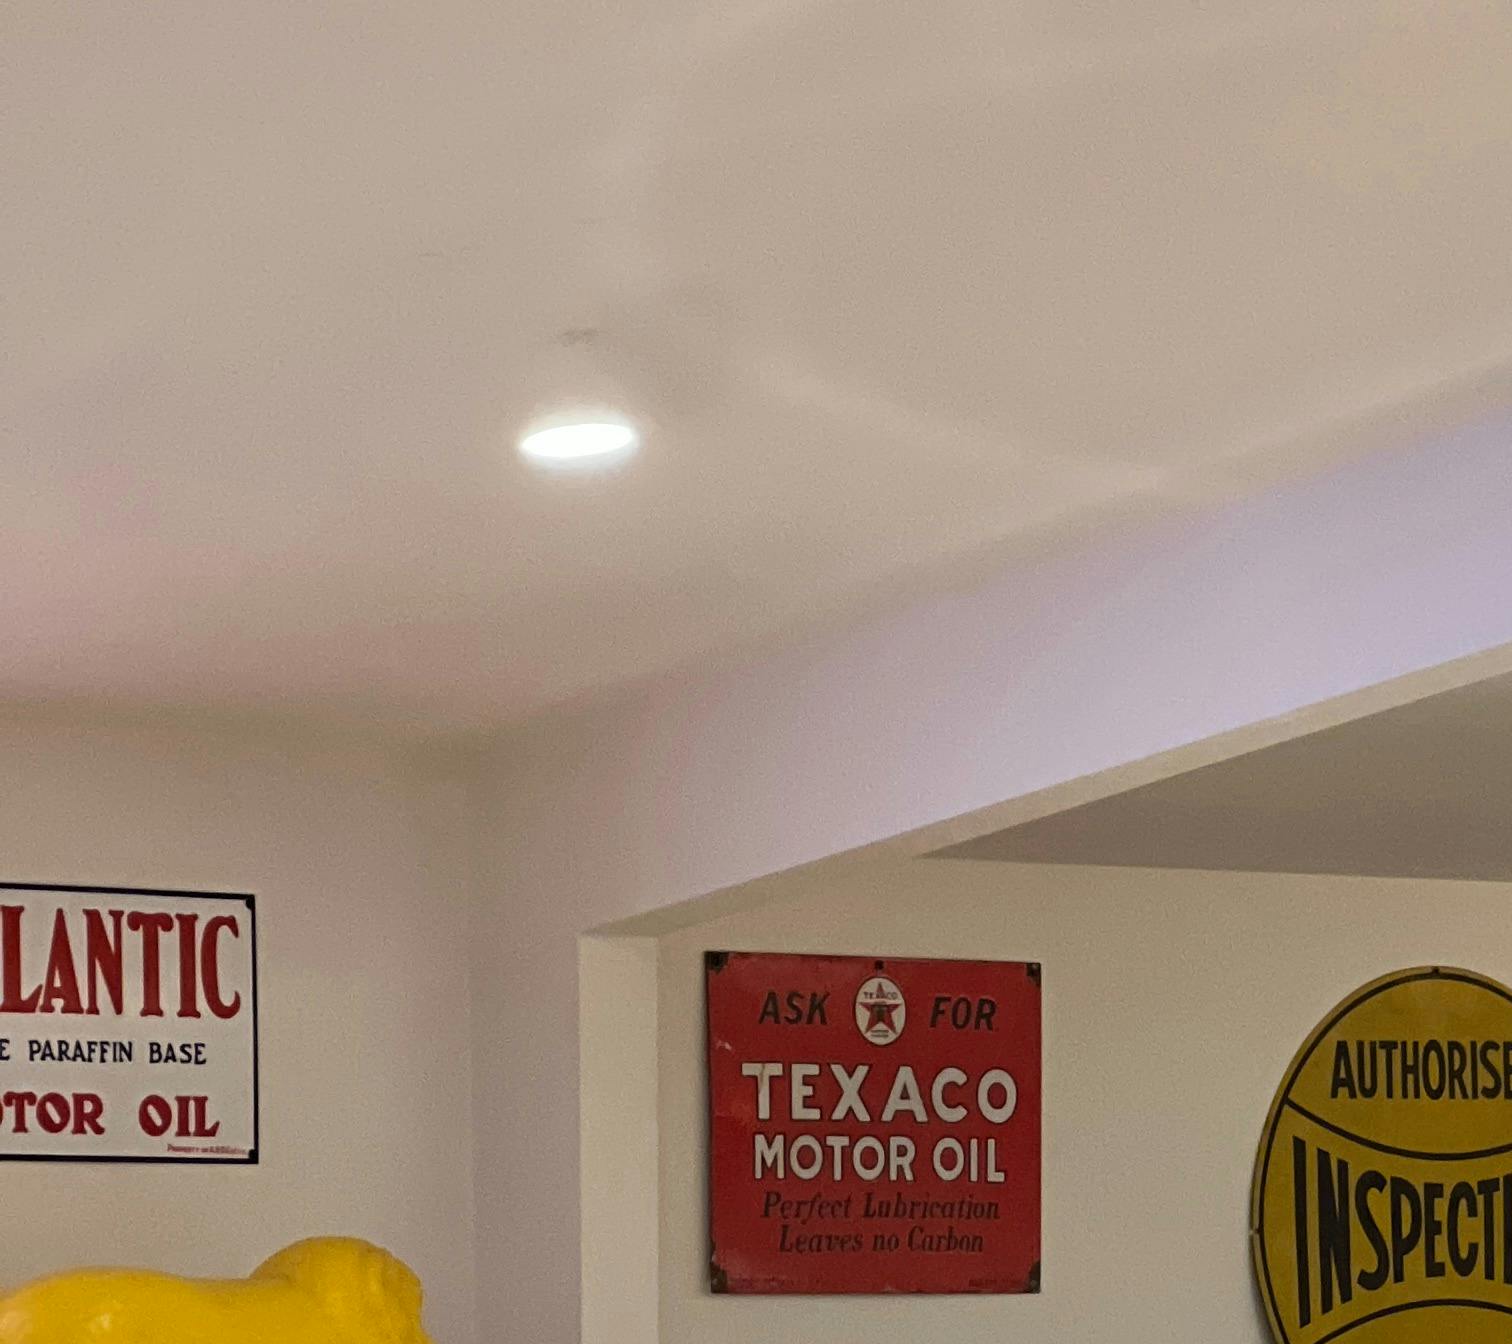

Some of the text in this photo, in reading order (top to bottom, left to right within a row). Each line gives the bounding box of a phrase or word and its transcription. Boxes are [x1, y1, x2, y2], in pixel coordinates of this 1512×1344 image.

[757, 991, 999, 1032] ASK FOR
[28, 1039, 133, 1064] PARAFFIN
[149, 1042, 207, 1066] BASE
[741, 1062, 1018, 1124] TEXACO
[0, 1091, 221, 1138] TOR OIL
[754, 1134, 1006, 1183] MOTOR OIL
[760, 1191, 1002, 1226] Perfect Lubrication
[778, 1224, 985, 1254] Leaves no Carbon
